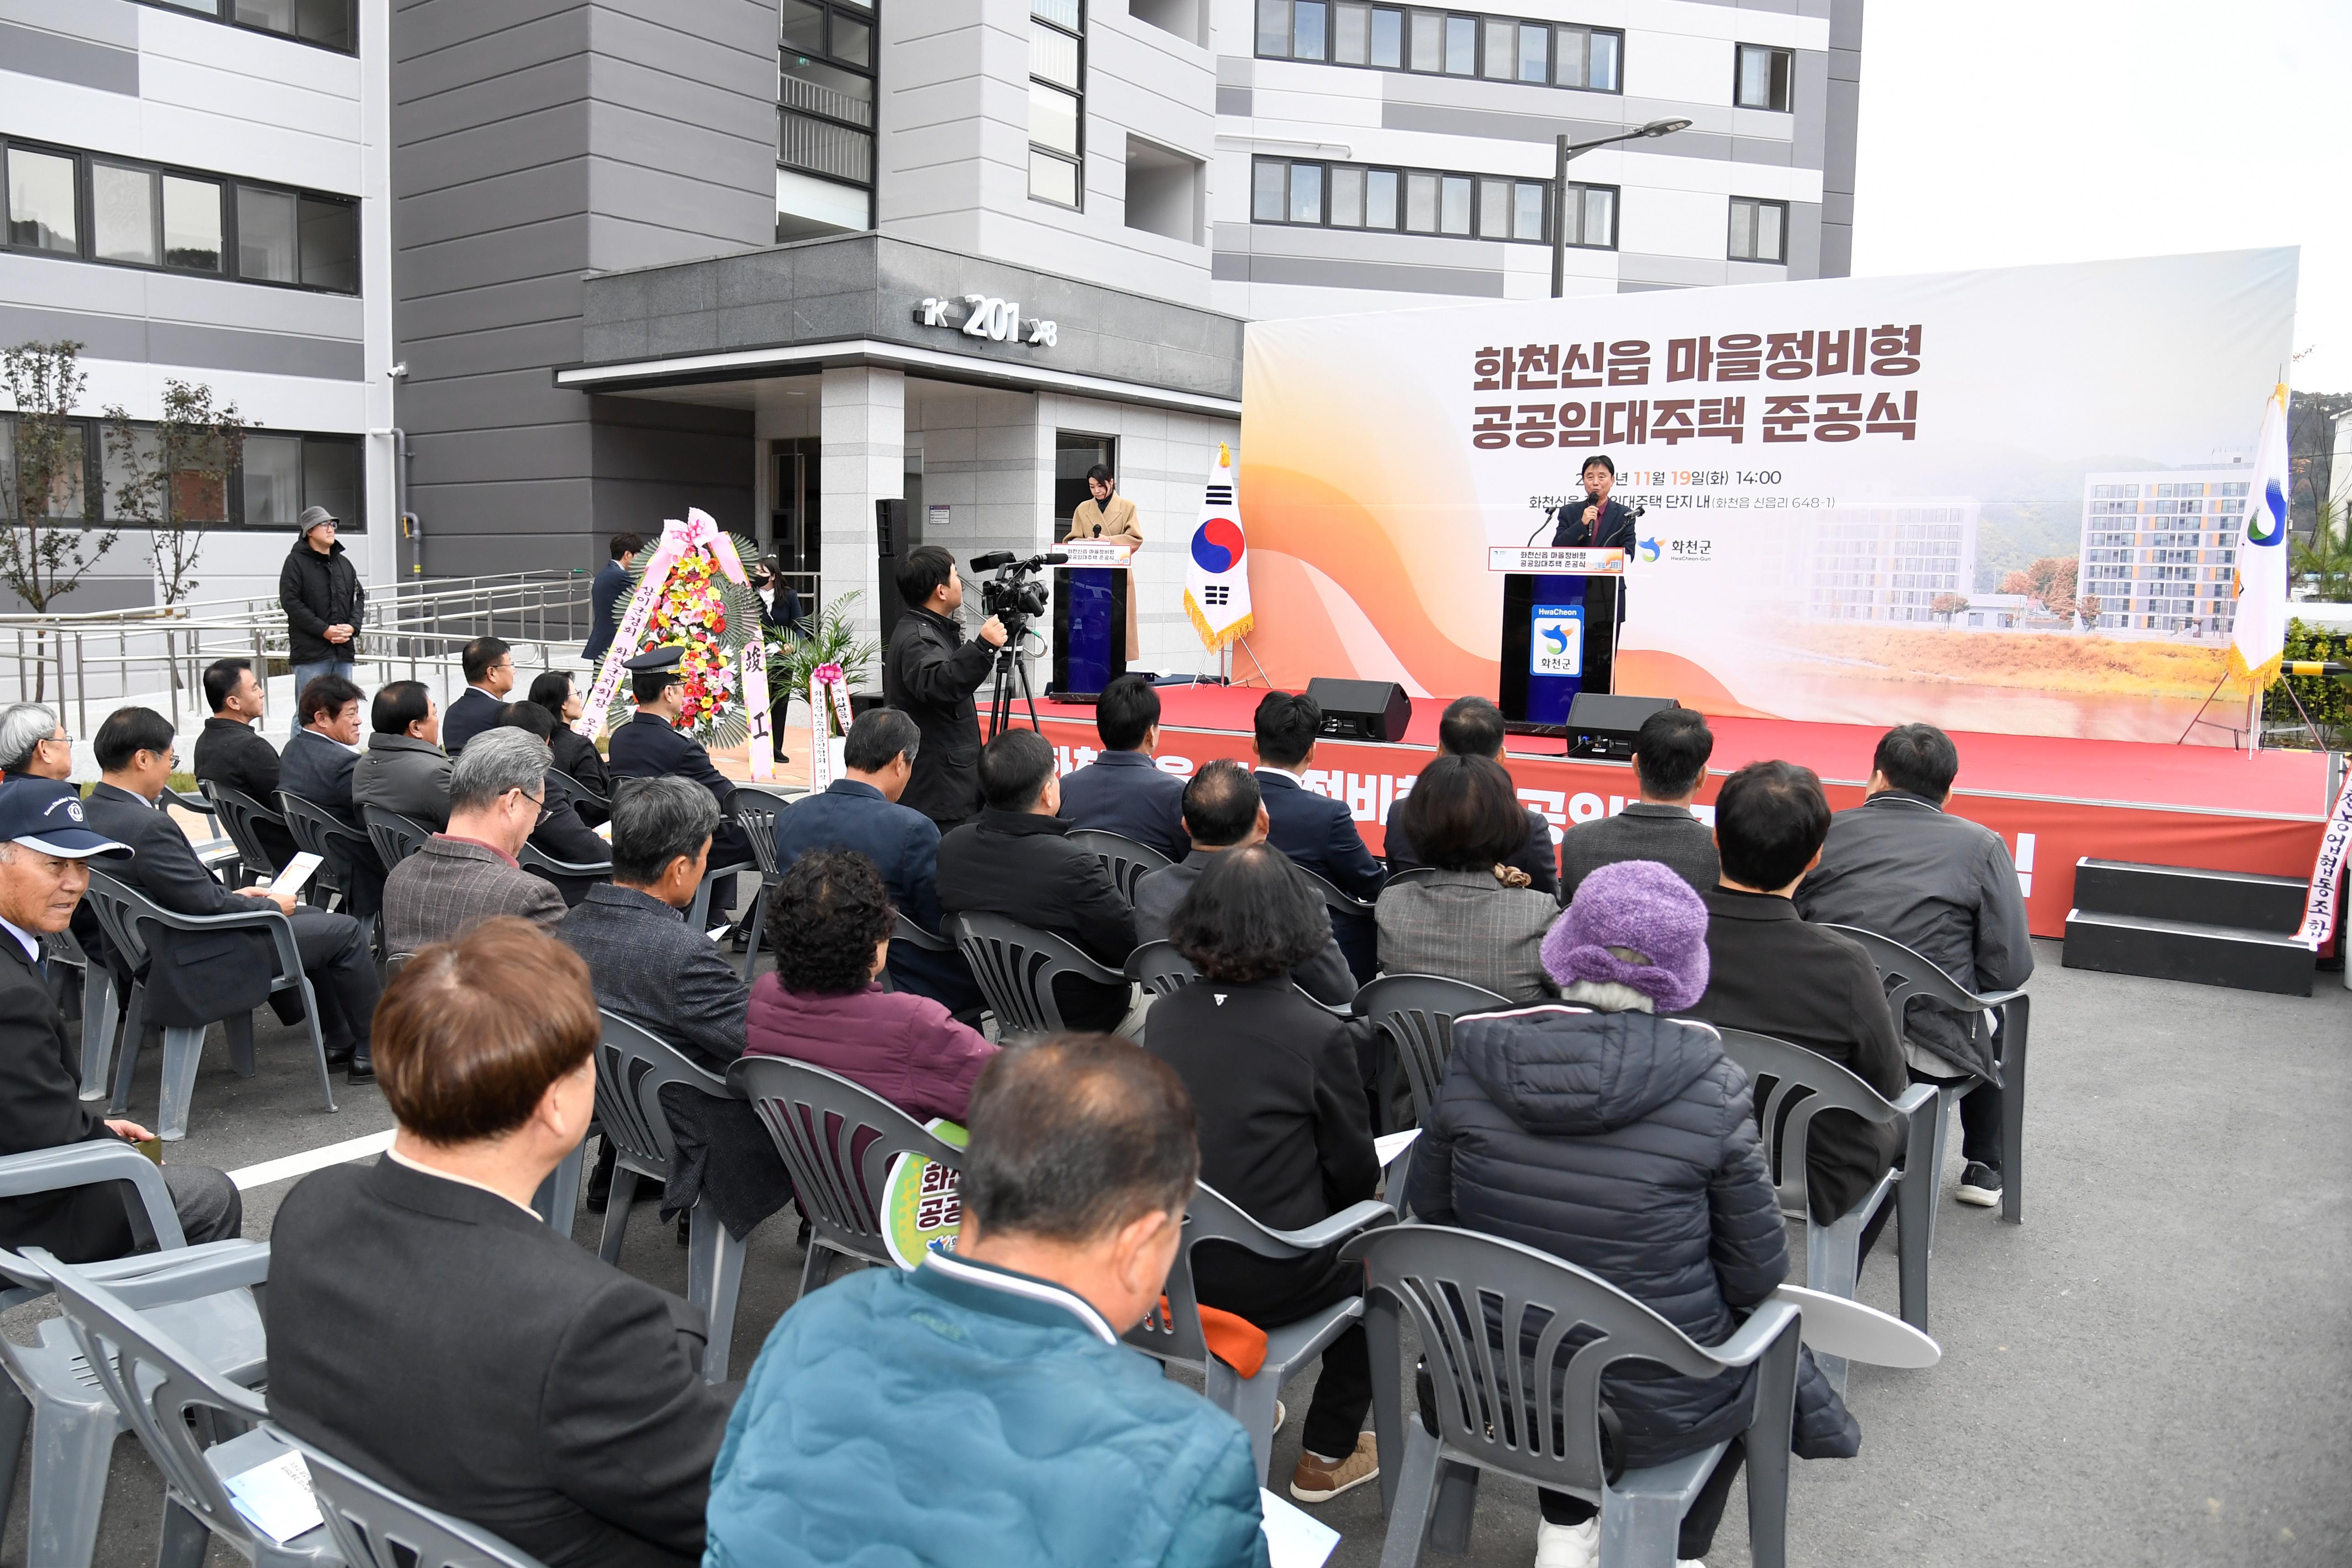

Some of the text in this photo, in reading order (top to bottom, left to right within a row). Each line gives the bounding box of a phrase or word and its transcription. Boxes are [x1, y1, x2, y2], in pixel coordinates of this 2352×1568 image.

[963, 294, 1019, 342] 201
[1473, 325, 1922, 391] 화천신읍 마을정비형
[1472, 390, 1919, 450] 공공임대주택 준공식
[1634, 471, 1666, 486] 11월
[1671, 471, 1729, 486] 19일(화)
[1736, 471, 1782, 485] 14:00
[1666, 495, 1693, 509] 단지
[1754, 496, 1788, 509] 신읍리
[1792, 496, 1835, 509] 648-1)
[1672, 540, 1712, 554] 화천군
[1541, 658, 1571, 670] 화천군
